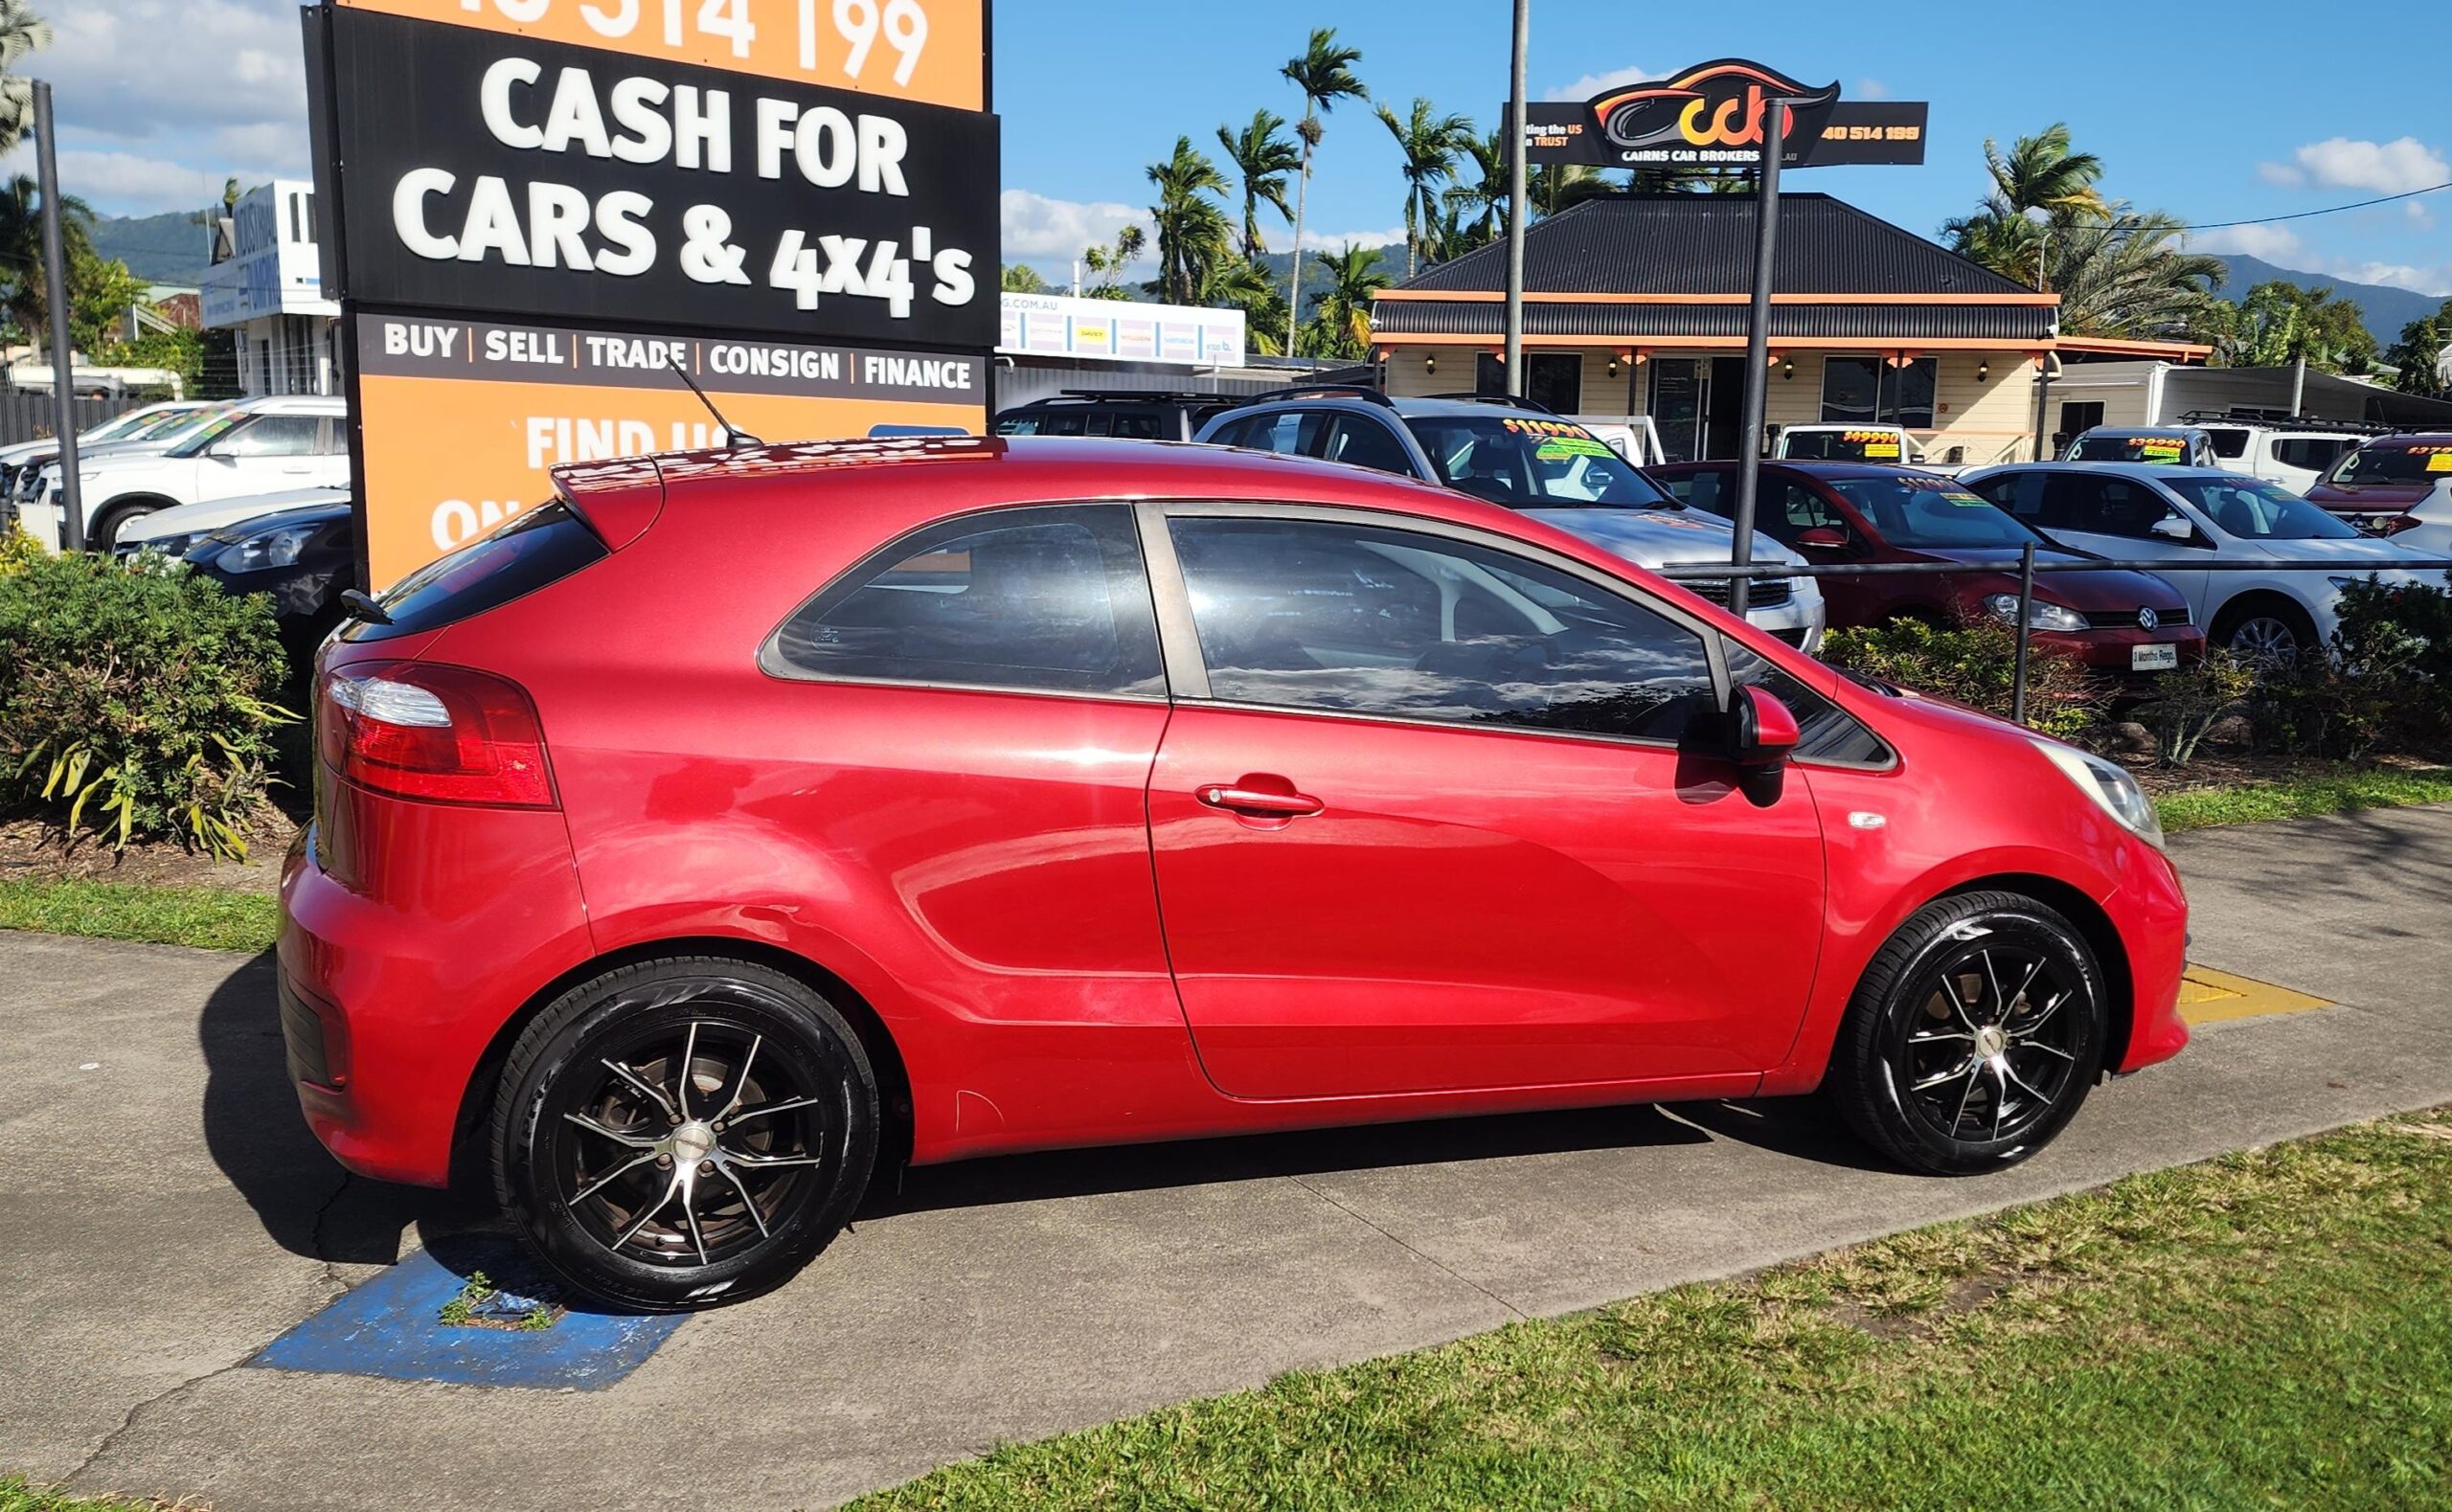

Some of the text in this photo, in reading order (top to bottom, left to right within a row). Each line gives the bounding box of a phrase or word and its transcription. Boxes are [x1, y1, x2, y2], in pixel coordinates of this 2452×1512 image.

[799, 0, 928, 87] 199
[481, 57, 909, 196] CASH FOR
[1526, 124, 1582, 136] ting the US
[1821, 126, 1848, 140] 40
[1850, 126, 1883, 140] 514
[1526, 136, 1568, 147] n TRUST
[1622, 150, 1669, 162] CAIRNS
[1671, 150, 1697, 162] CAR
[1699, 150, 1760, 162] BROKERS
[392, 168, 657, 277] CARS
[680, 204, 751, 285] &
[1002, 298, 1057, 311] G.COM.AU
[384, 323, 971, 390] BUY SELL TRADE CONSIGN FINANCE
[1503, 418, 1590, 439] $11990
[527, 417, 656, 469] FIND
[1843, 431, 1899, 443] $49990
[2128, 438, 2187, 448] $39990
[2138, 650, 2158, 662] Months
